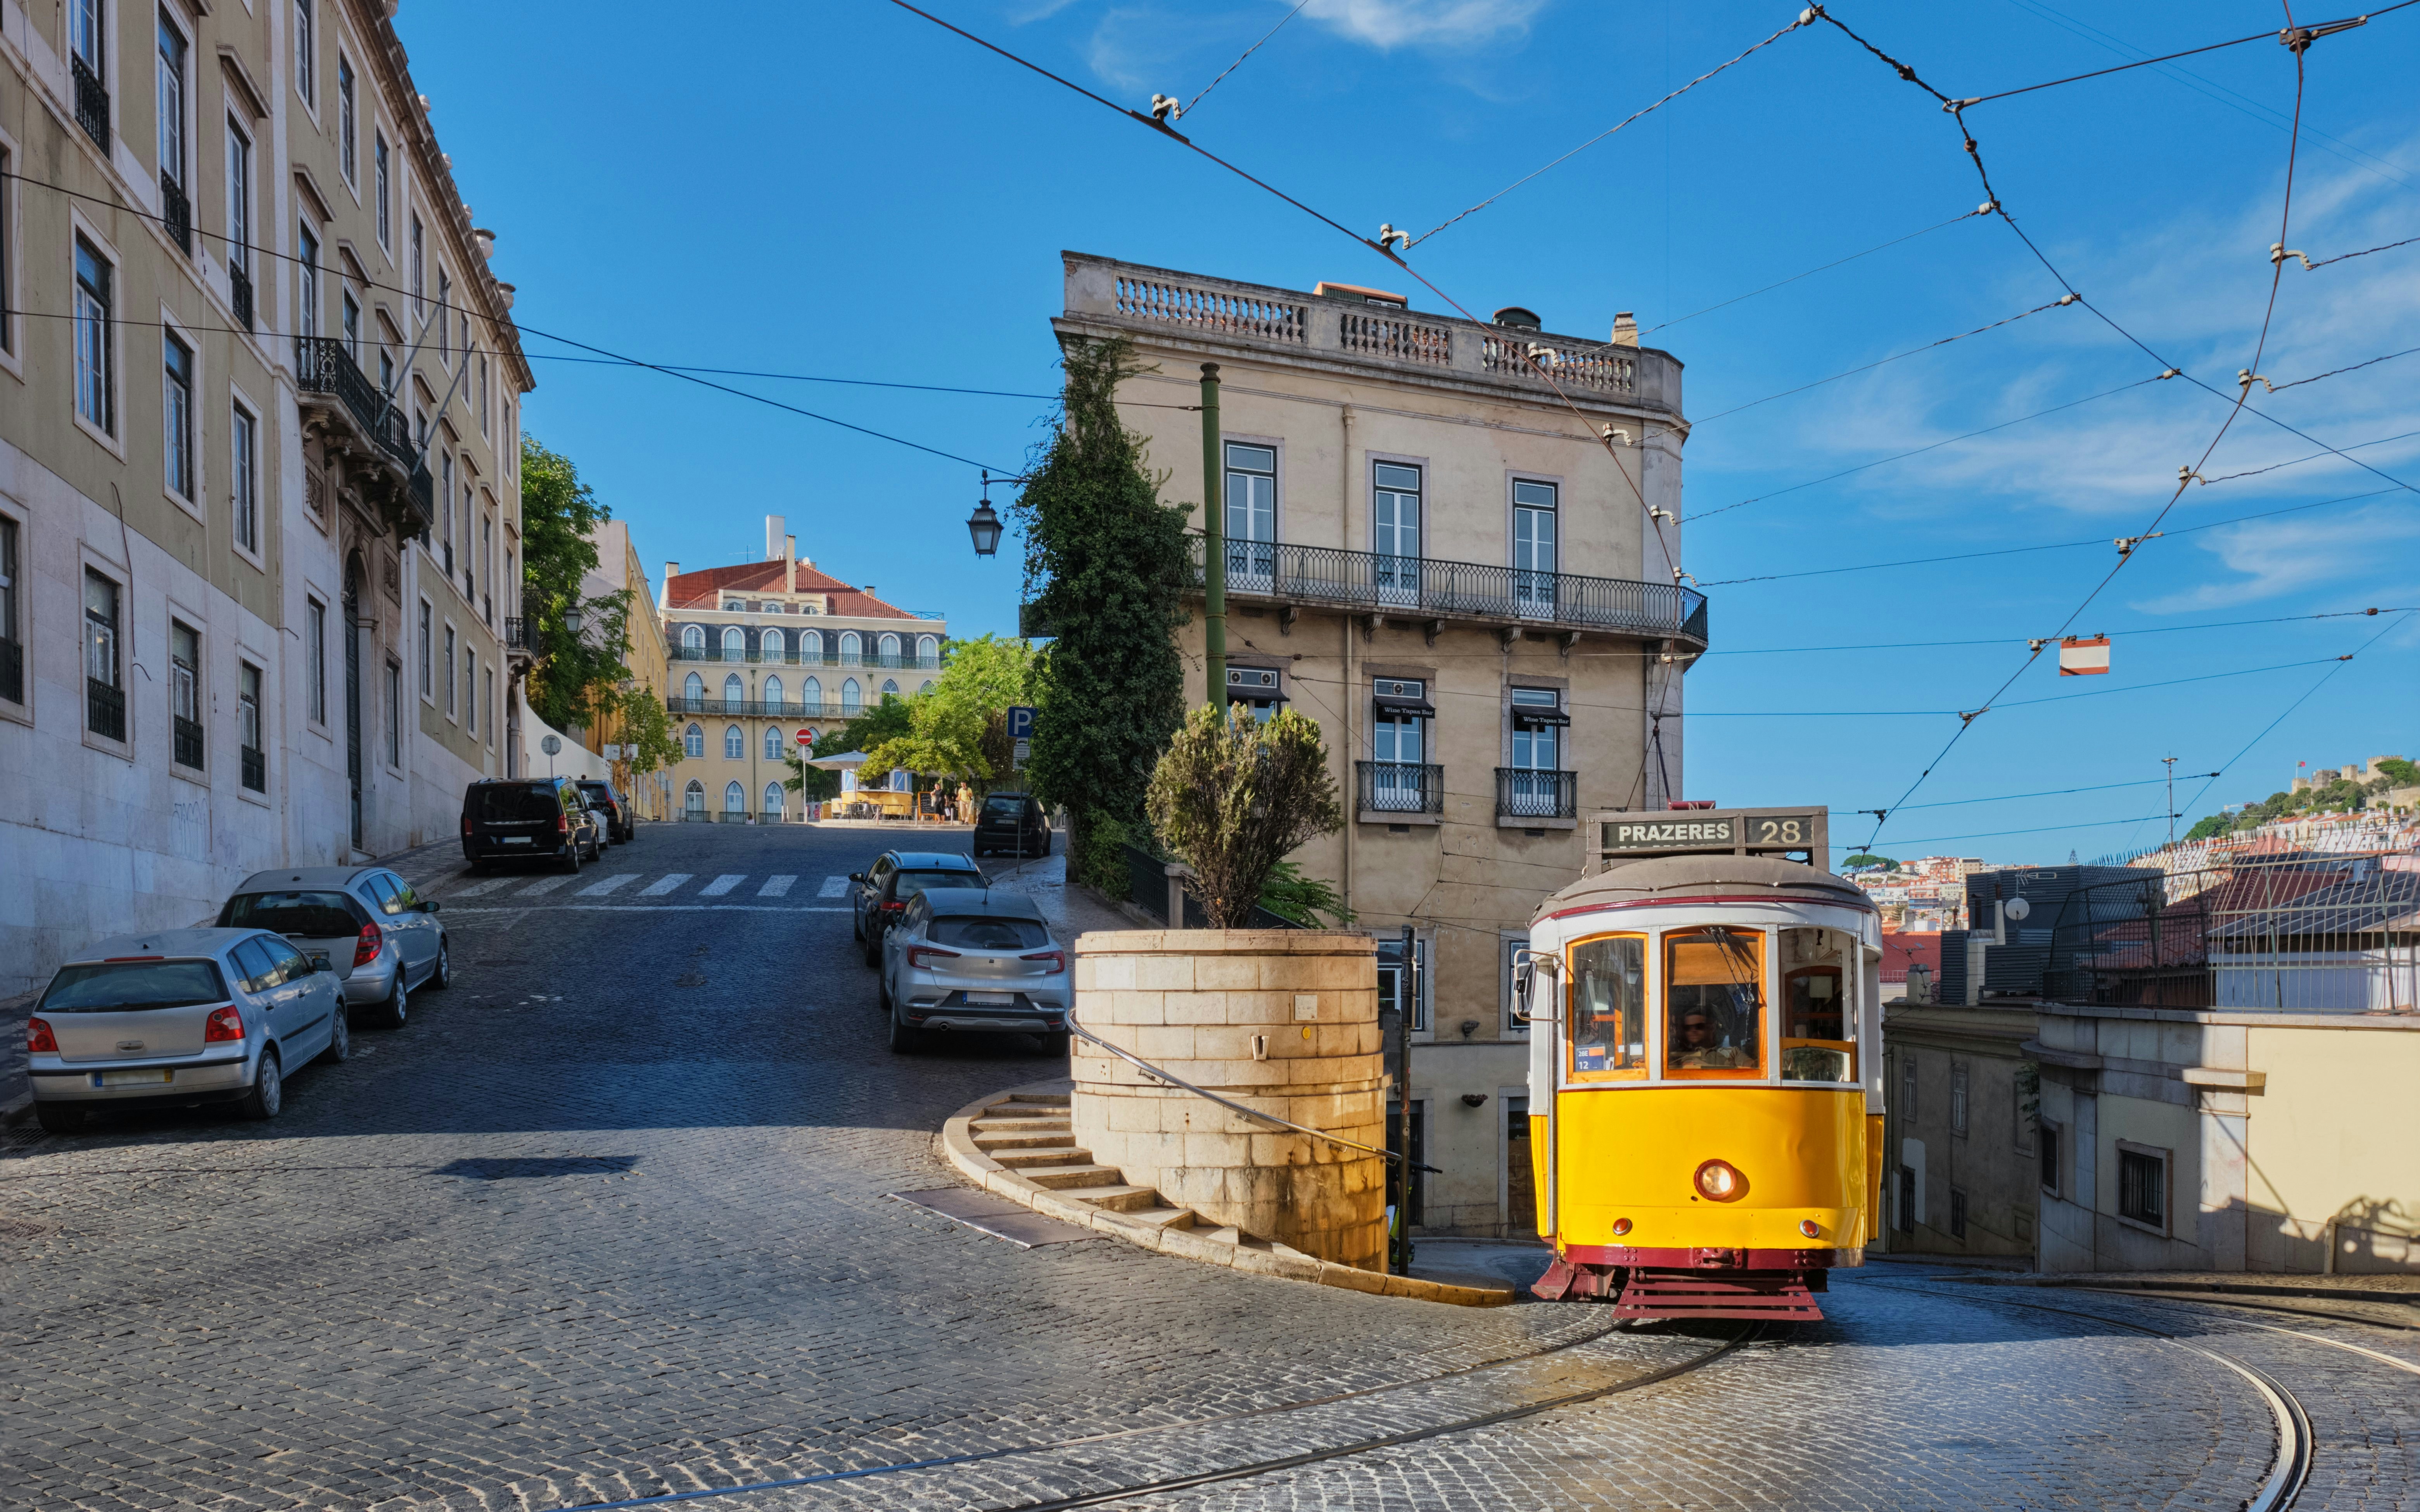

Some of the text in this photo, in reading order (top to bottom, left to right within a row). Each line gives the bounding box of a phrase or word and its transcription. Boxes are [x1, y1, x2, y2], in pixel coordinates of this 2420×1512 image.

[1014, 709, 1032, 734] P
[1619, 823, 1730, 842] PRAZERES
[1761, 820, 1801, 844] 28
[1579, 1061, 1588, 1069] 12
